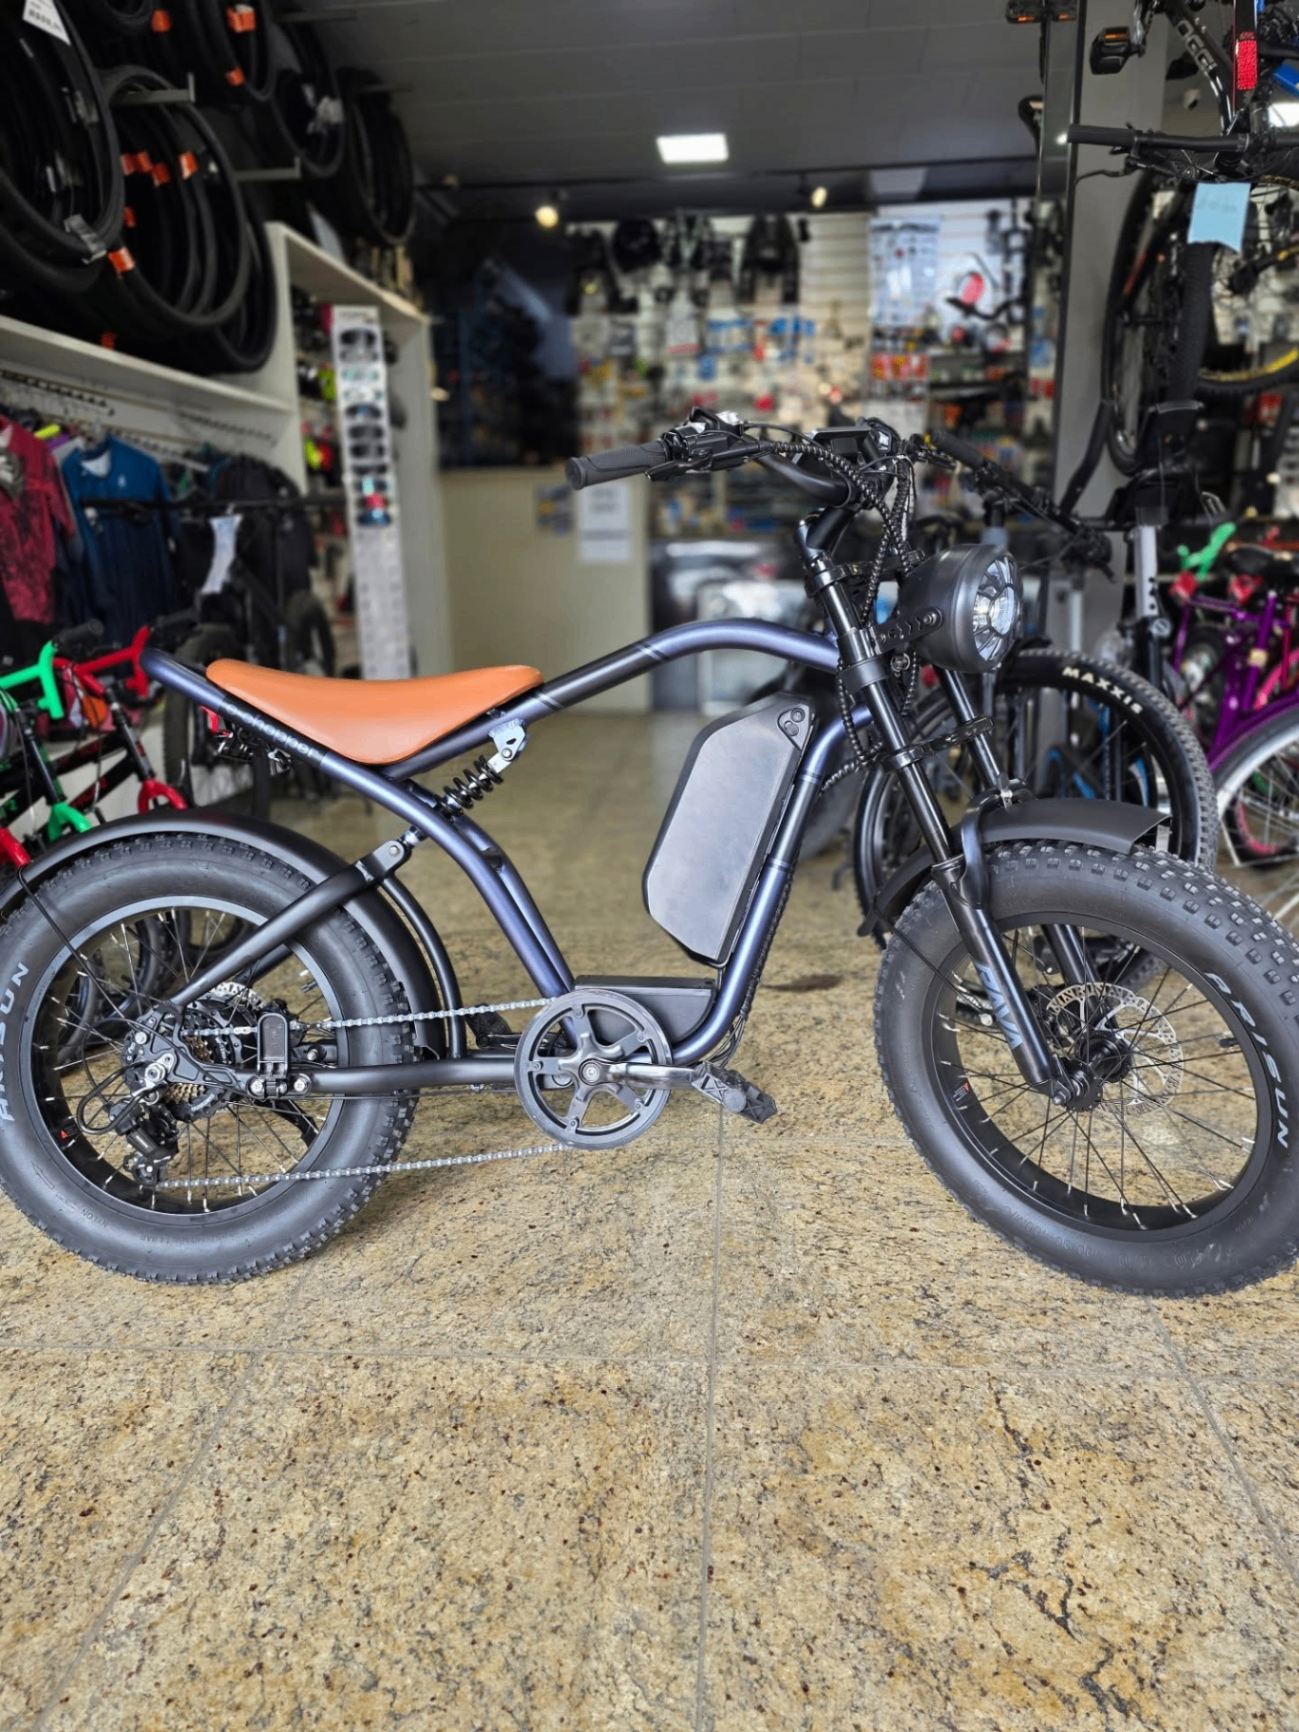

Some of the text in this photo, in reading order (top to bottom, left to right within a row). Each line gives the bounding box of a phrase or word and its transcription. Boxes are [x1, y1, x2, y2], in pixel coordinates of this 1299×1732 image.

[1178, 19, 1218, 77] OGGI
[1062, 666, 1143, 714] MAXXIS
[1204, 972, 1288, 1149] ARISUN
